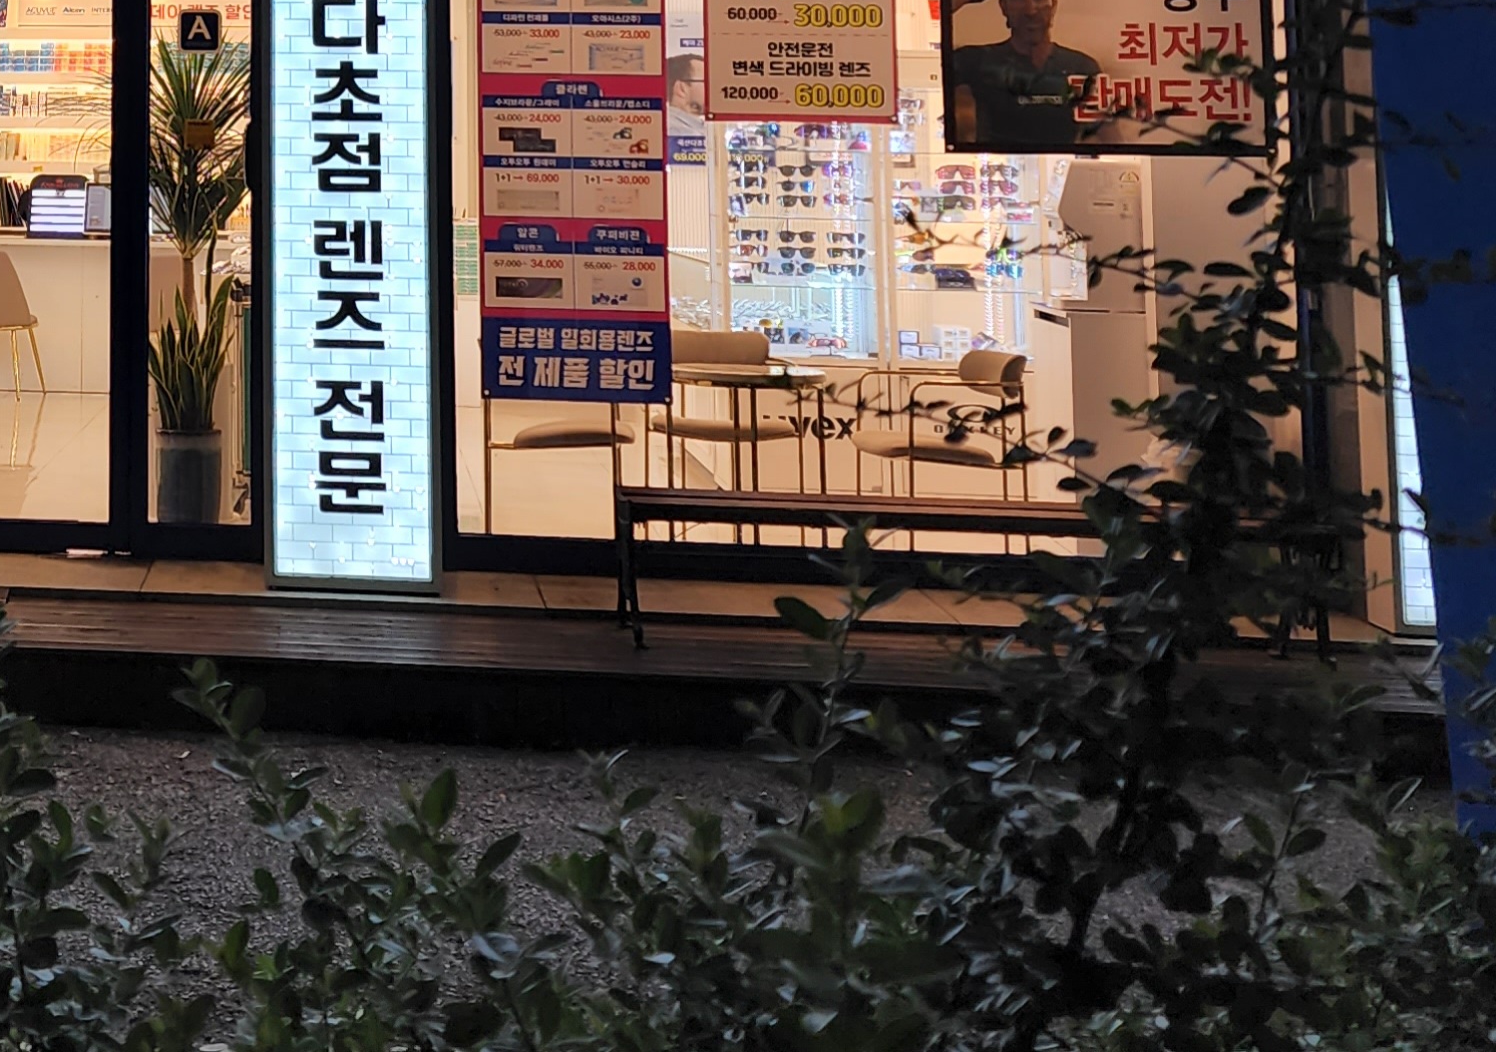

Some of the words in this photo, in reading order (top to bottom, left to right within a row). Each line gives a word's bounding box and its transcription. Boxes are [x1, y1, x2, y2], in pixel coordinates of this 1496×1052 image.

[187, 15, 212, 40] A
[727, 7, 778, 21] 60,000
[793, 4, 883, 28] 30,000
[768, 42, 834, 58] 안전운전
[1117, 21, 1249, 67] 최저가
[732, 60, 764, 76] 변색
[769, 61, 834, 77] 드라이빙
[839, 61, 871, 78] 렌즈
[556, 84, 588, 95] 클라렌
[721, 87, 779, 101] 120,000
[794, 83, 884, 108] 60,000
[516, 227, 539, 239] 알콘
[596, 229, 641, 241] 쿠퍼비전
[311, 219, 386, 350] 렌즈
[499, 327, 554, 349] 글로벌
[561, 328, 654, 352] 일회용렌즈
[498, 355, 525, 386] 전
[533, 356, 589, 388] 제품
[599, 359, 655, 390] 할인
[763, 414, 858, 441] vex
[934, 425, 1015, 436] OKLEY
[311, 379, 388, 516] 전문
